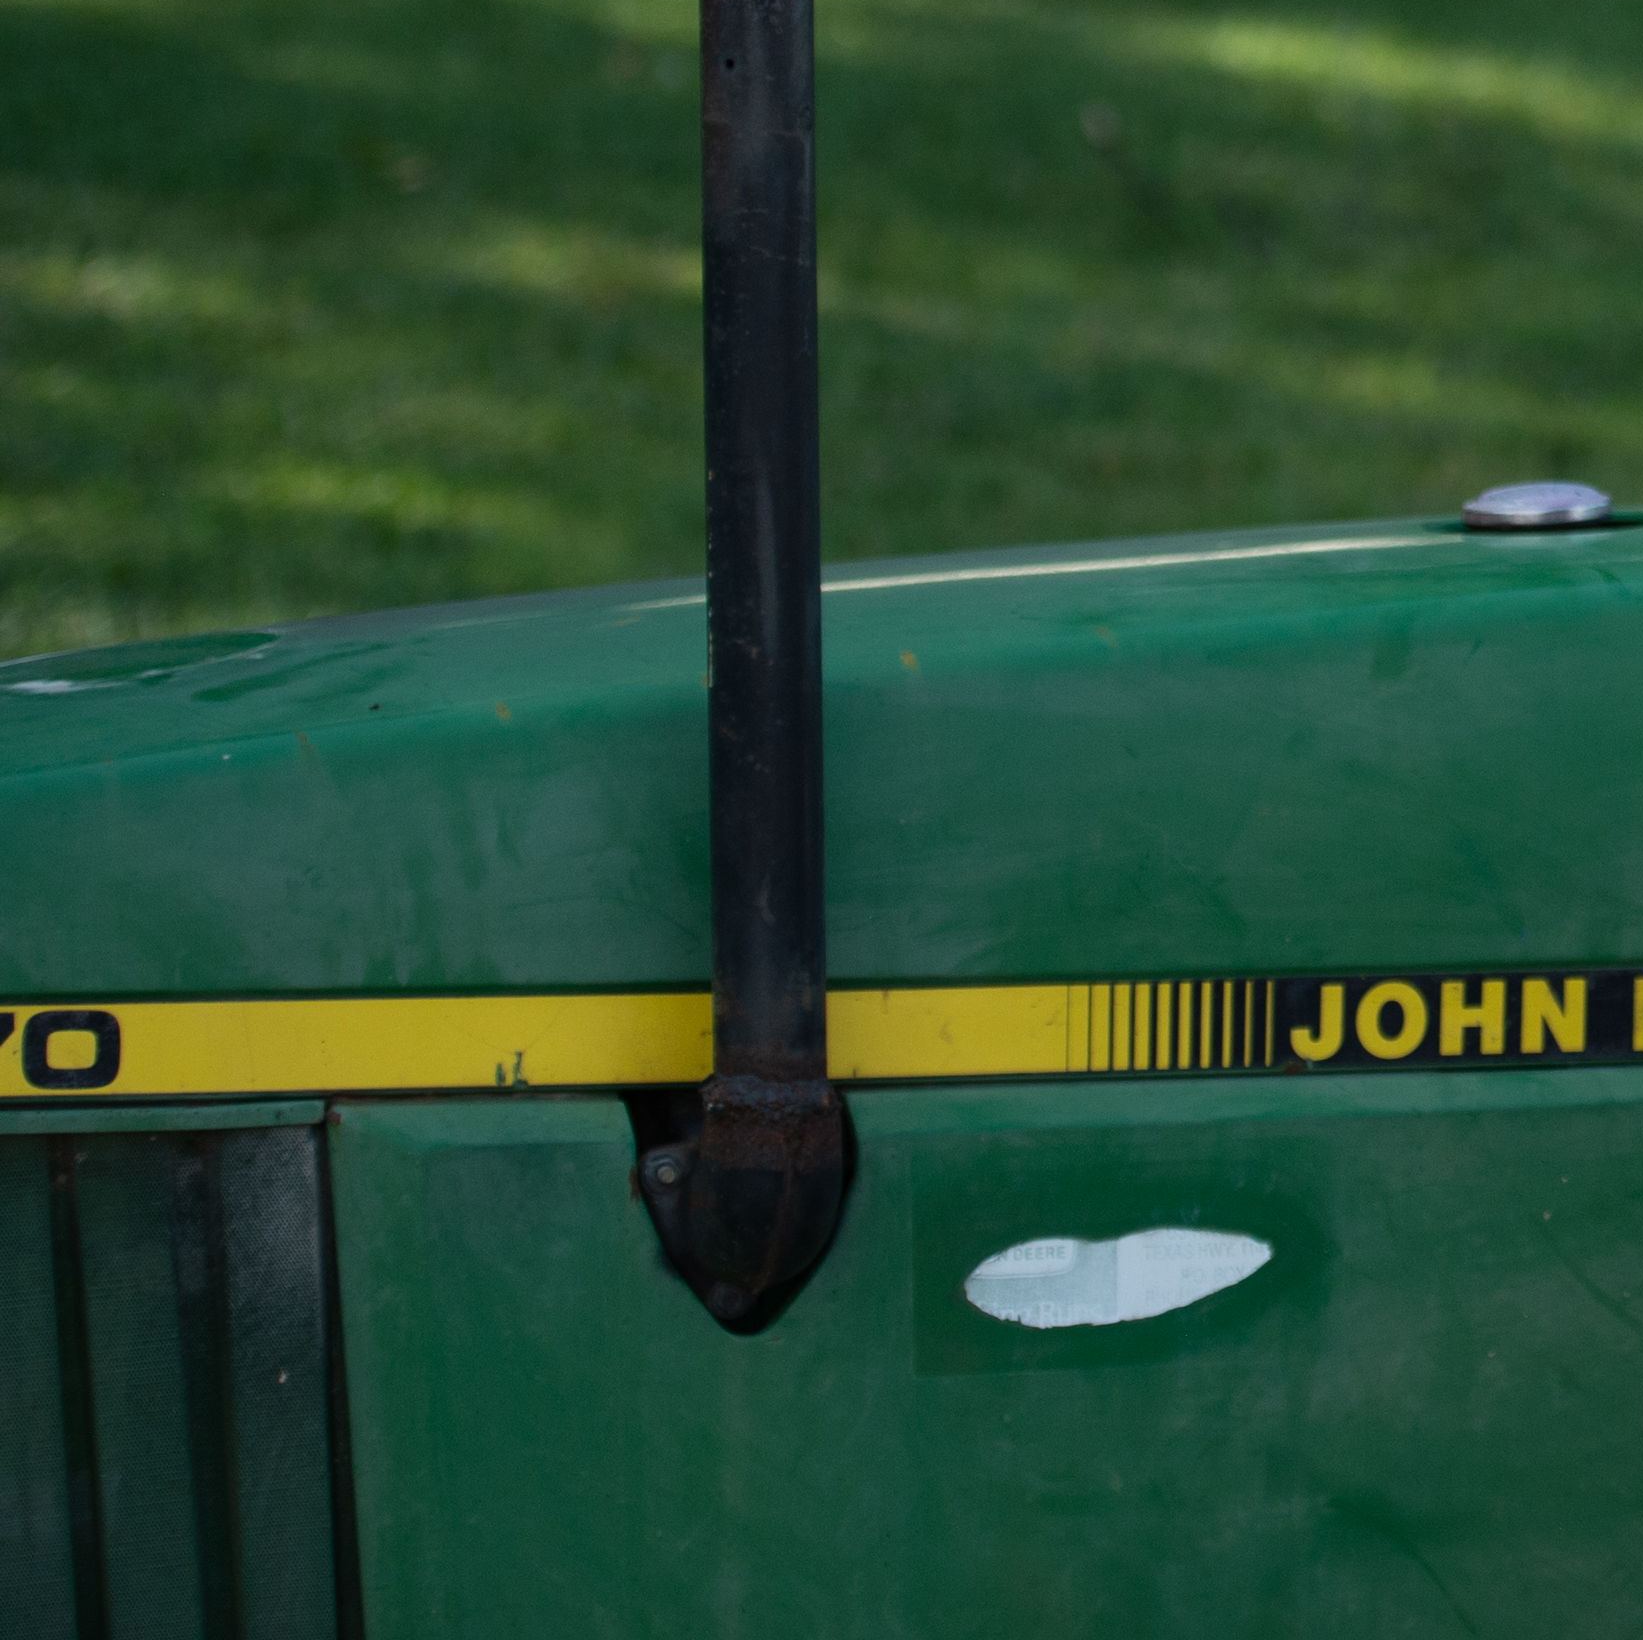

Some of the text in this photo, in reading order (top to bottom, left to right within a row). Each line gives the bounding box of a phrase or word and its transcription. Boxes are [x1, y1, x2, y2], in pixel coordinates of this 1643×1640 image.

[1290, 978, 1587, 1060] JOHN
[1013, 1245, 1066, 1262] DEERE
[1144, 1242, 1193, 1261] TEXAS
